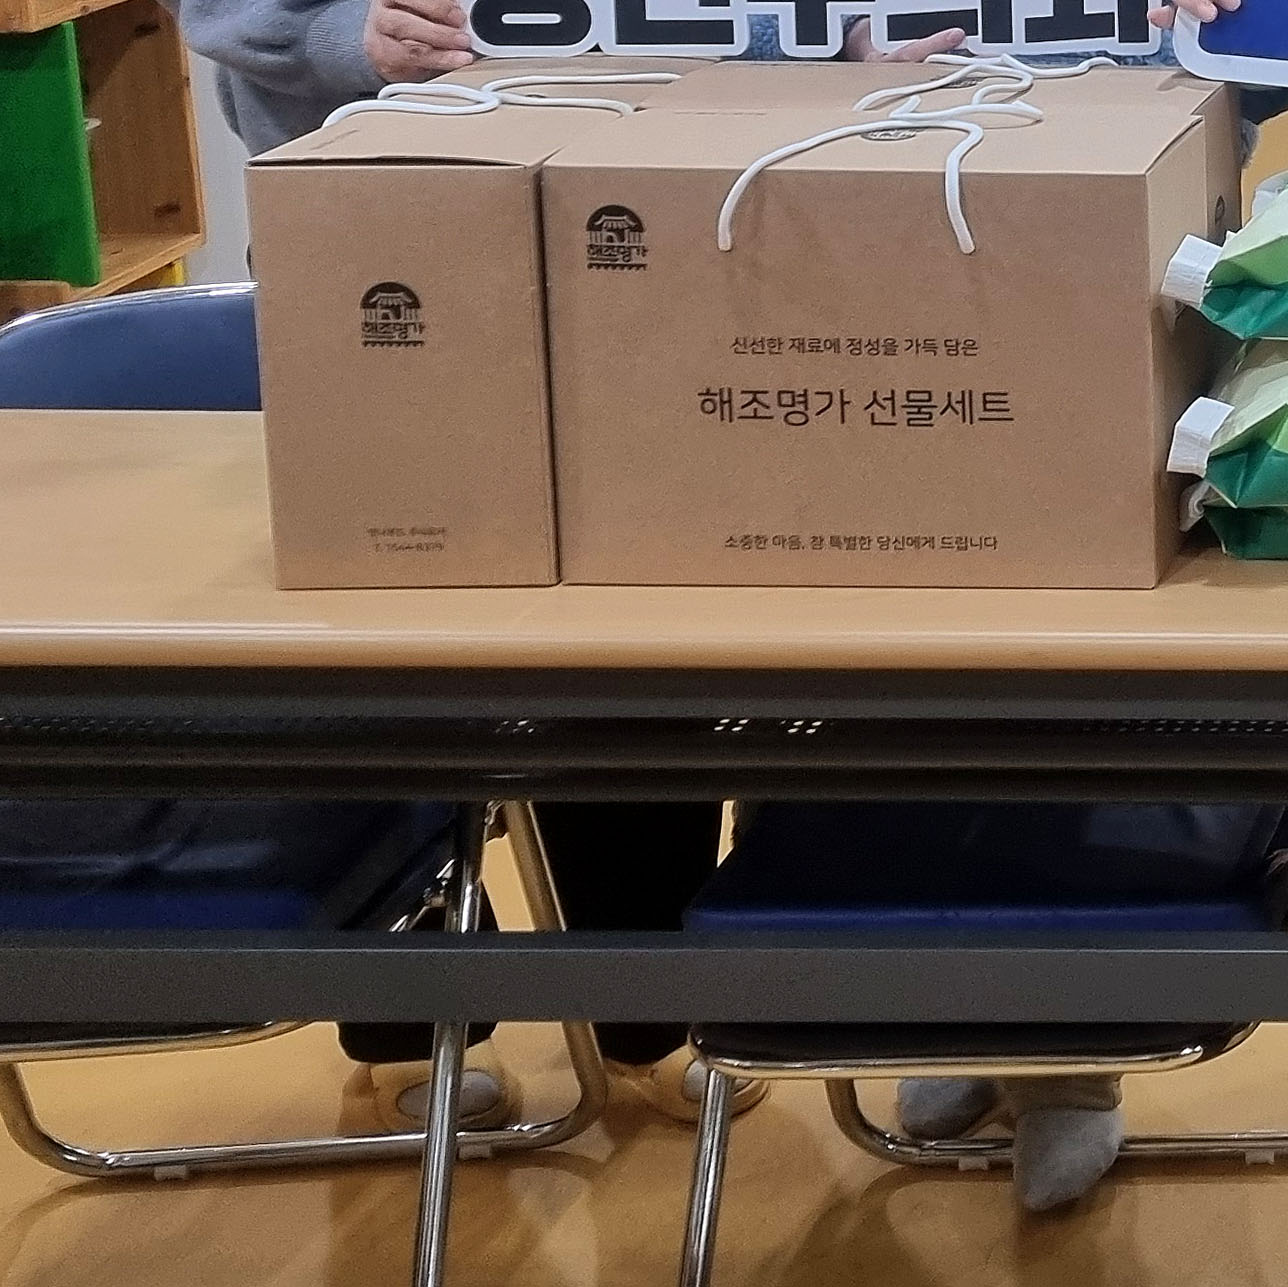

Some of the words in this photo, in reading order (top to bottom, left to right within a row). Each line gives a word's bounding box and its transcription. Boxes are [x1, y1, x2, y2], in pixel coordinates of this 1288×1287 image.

[732, 337, 783, 355] 신선한
[788, 337, 841, 354] 재료에
[846, 337, 899, 357] 정성을
[904, 338, 939, 357] 가득
[943, 338, 979, 357] 담은
[697, 387, 851, 427] 해조명가
[863, 389, 1015, 428] 선물세트
[940, 536, 998, 552] 드립니다
